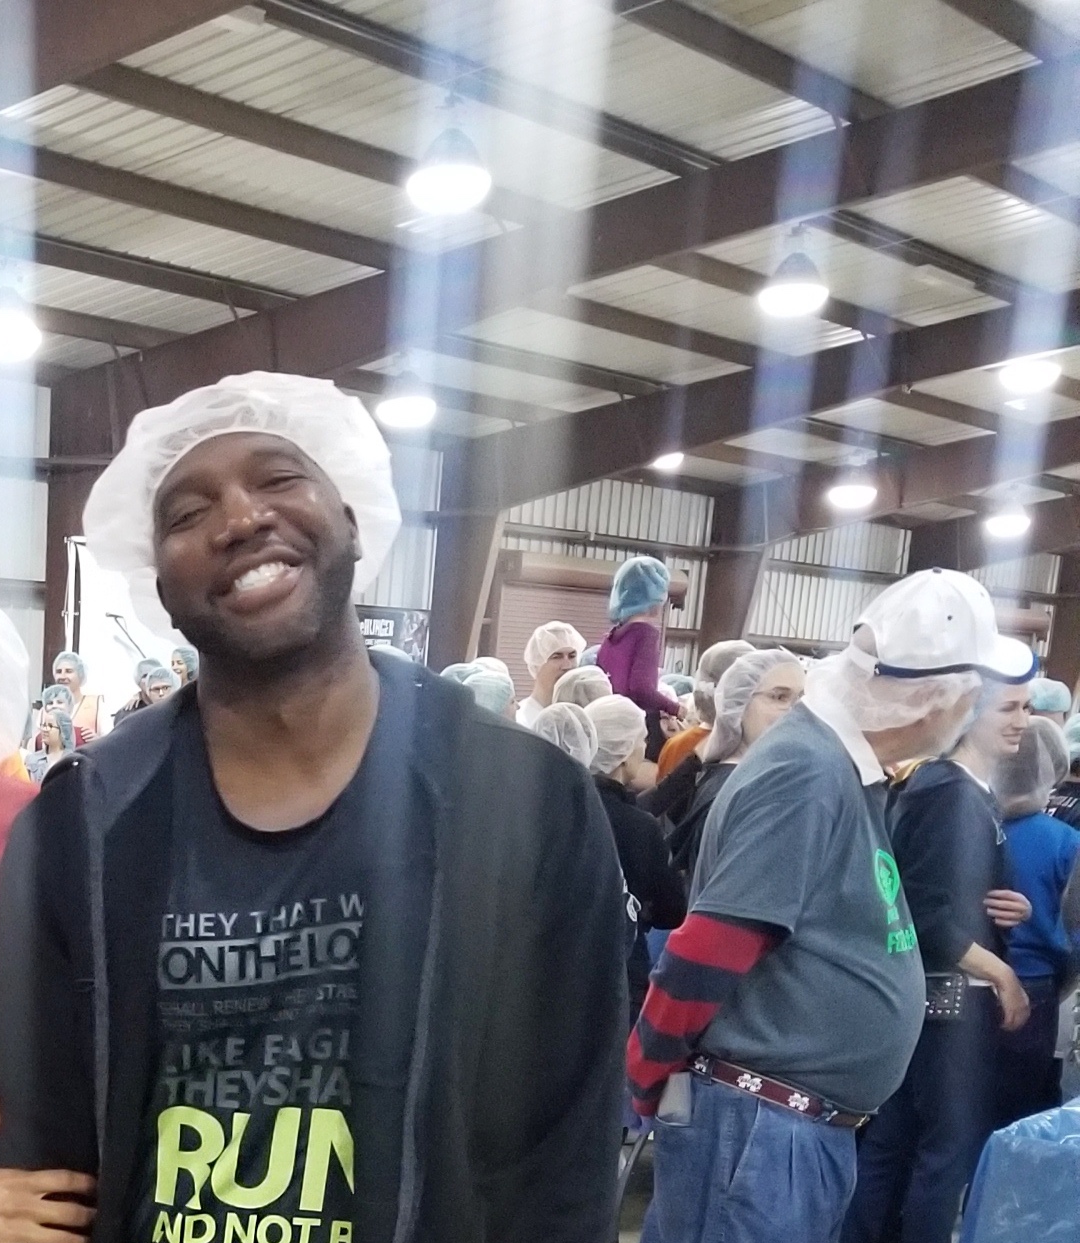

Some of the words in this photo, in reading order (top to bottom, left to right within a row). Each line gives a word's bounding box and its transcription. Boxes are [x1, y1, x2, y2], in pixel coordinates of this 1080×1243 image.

[161, 911, 239, 938] THEY
[249, 897, 328, 934] THAT
[155, 1105, 355, 1212] RUN
